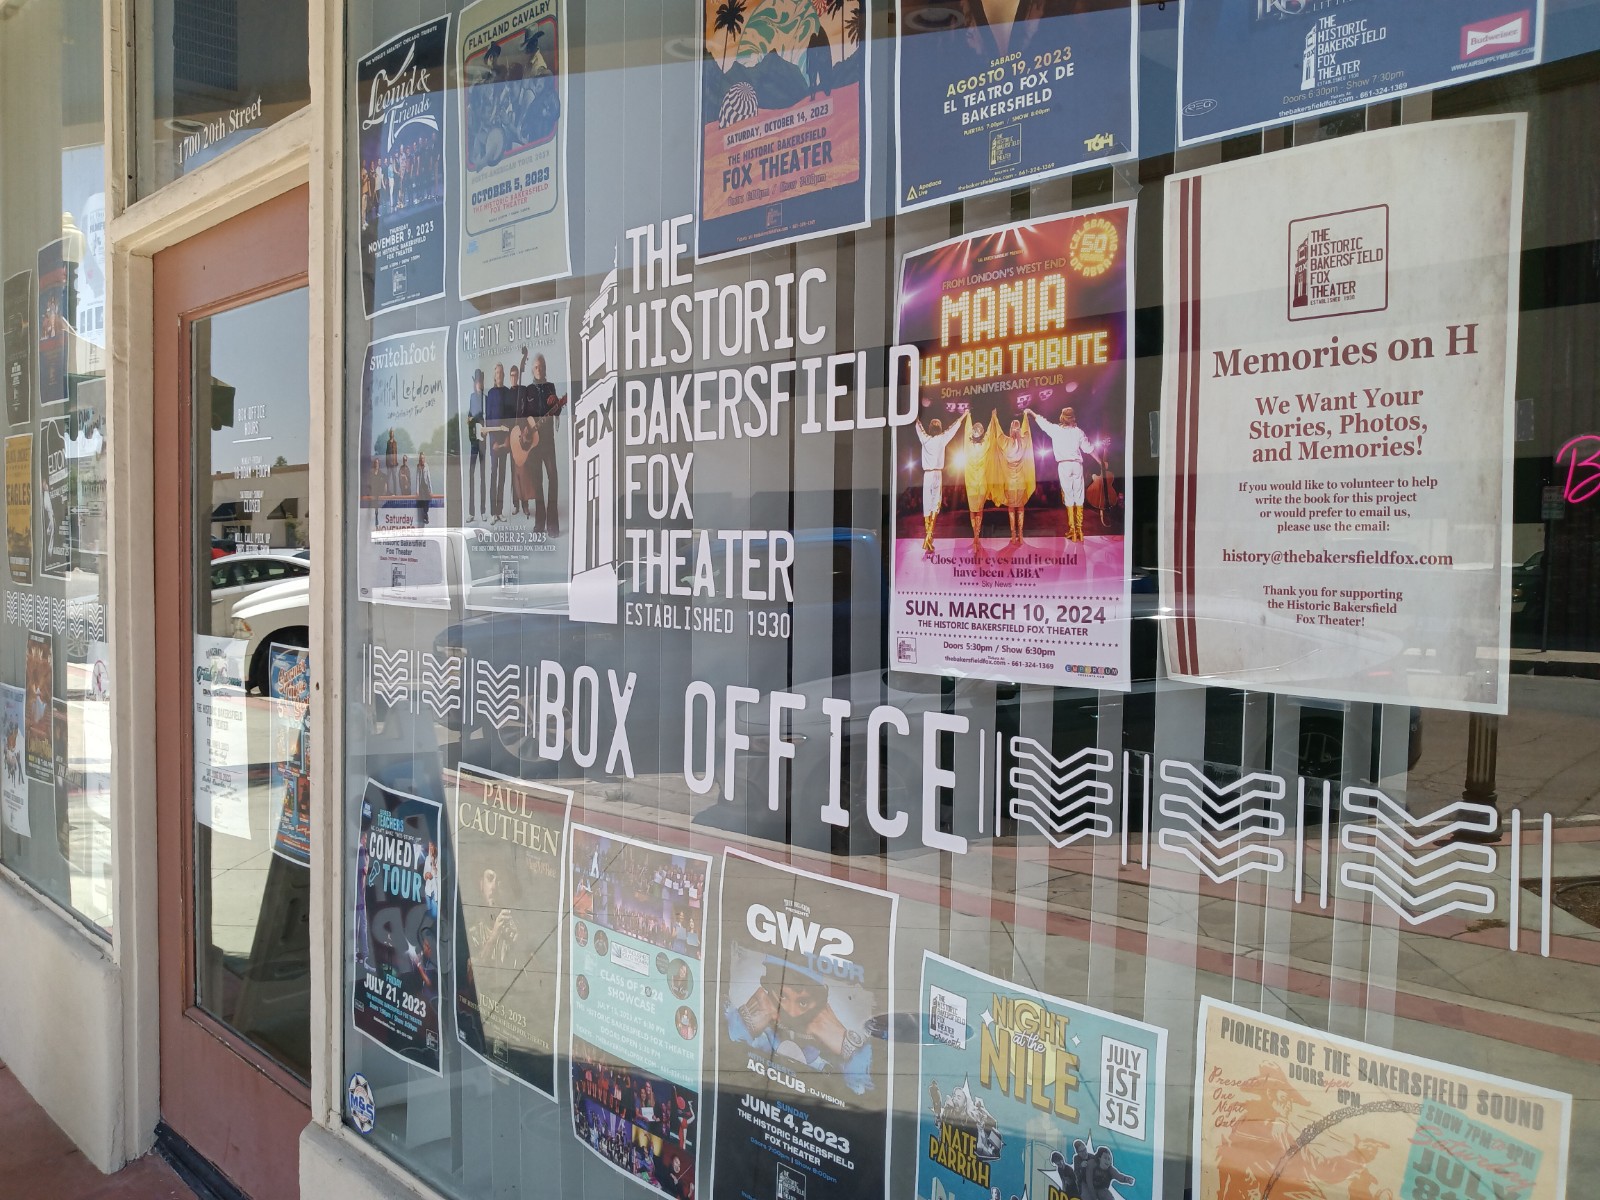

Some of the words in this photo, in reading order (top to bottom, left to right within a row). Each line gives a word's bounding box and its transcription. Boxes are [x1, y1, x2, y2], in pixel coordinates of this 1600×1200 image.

[469, 21, 510, 50] FLATLAND
[512, 0, 551, 28] CAVALRY
[1317, 19, 1368, 43] HISTORIC
[1318, 14, 1337, 30] THE
[1470, 29, 1519, 46] Budweiser
[990, 51, 1022, 68] SABADO
[1317, 27, 1387, 56] BAKERSFIELD
[946, 67, 1005, 98] AGOSTO
[1012, 60, 1031, 76] 19,
[1034, 46, 1072, 70] 2023
[1317, 52, 1336, 69] FOX
[1317, 59, 1361, 81] THEATER
[418, 68, 431, 93] &
[943, 99, 958, 114] EL
[963, 81, 1014, 108] TEATRO
[1020, 70, 1049, 91] FOX
[1055, 62, 1075, 81] DE
[726, 126, 762, 146] SATURDAY,
[764, 116, 795, 133] OCTOBER
[796, 111, 808, 123] 14,
[810, 104, 829, 119] 2023
[961, 88, 1053, 126] BAKERSFIELD
[178, 132, 201, 165] 1700
[203, 117, 226, 150] 20th
[228, 94, 262, 134] Street
[722, 162, 753, 193] FOX
[759, 140, 833, 181] THEATER
[471, 180, 512, 206] OCTOBER
[514, 177, 523, 191] 5,
[525, 167, 550, 186] 2023
[368, 231, 405, 254] NOVEMBER
[416, 220, 434, 237] 2023
[625, 214, 694, 294] THE
[942, 278, 966, 291] FROM
[966, 267, 1015, 285] LONDON'S
[1016, 263, 1042, 276] WEST
[1044, 257, 1067, 270] END
[625, 267, 827, 370] HISTORIC
[940, 273, 1066, 348] MANIA
[463, 323, 500, 352] MARTY
[508, 311, 559, 343] STUART
[369, 341, 437, 371] switchfoot
[947, 346, 1003, 383] ABBA
[1008, 331, 1108, 374] TRIBUTE
[1212, 335, 1378, 379] Memories
[1388, 334, 1435, 362] on
[1445, 323, 1479, 357] H
[625, 344, 920, 446] BAKERSFIELD
[1255, 396, 1291, 416] We
[1295, 391, 1358, 414] Want
[1363, 387, 1424, 409] Your
[574, 398, 613, 461] FOX
[1249, 416, 1332, 440] Stories,
[1339, 412, 1428, 436] Photos,
[1252, 440, 1292, 463] and
[1298, 434, 1423, 462] Memories!
[6, 482, 31, 506] EAGLES
[625, 452, 694, 520] FOX
[1238, 481, 1249, 493] If
[1249, 483, 1268, 493] you
[1269, 480, 1302, 492] would
[1304, 479, 1325, 490] like
[1326, 480, 1338, 490] to
[1340, 477, 1396, 490] volunteer
[1397, 478, 1409, 489] to
[1411, 476, 1438, 490] help
[1255, 494, 1283, 505] write
[1284, 493, 1303, 505] the
[1303, 493, 1331, 504] book
[1332, 493, 1350, 504] for
[1352, 492, 1374, 503] this
[1375, 492, 1417, 505] project
[385, 514, 414, 526] Saturday
[1259, 509, 1272, 518] or
[1274, 507, 1306, 518] would
[1308, 507, 1344, 521] prefer
[1345, 507, 1357, 517] to
[1358, 506, 1391, 517] email
[1393, 508, 1411, 519] us,
[1277, 521, 1311, 534] please
[1313, 523, 1332, 532] use
[1334, 522, 1352, 532] the
[1354, 521, 1390, 532] email:
[625, 529, 795, 602] THEATER
[953, 566, 978, 578] have
[979, 567, 1004, 578] been
[1222, 549, 1454, 566] history@thebakersfieldfox.com
[1262, 585, 1297, 597] Thank
[1298, 588, 1319, 599] you
[1321, 587, 1338, 598] for
[1339, 588, 1403, 601] supporting
[1267, 599, 1285, 610] the
[1286, 600, 1331, 611] Historic
[1332, 601, 1397, 614] Bakersfield
[625, 602, 734, 634] ESTABLISHED
[747, 611, 790, 639] 1930
[905, 600, 944, 618] SUN.
[949, 601, 1016, 621] MARCH
[1023, 603, 1050, 625] 10,
[1056, 605, 1107, 625] 2024
[918, 619, 933, 629] THE
[933, 620, 970, 630] HISTORIC
[971, 622, 1025, 633] BAKERSFIELD
[1026, 624, 1045, 634] FOX
[1046, 626, 1089, 637] THEATER
[1296, 613, 1315, 625] Fox
[1317, 614, 1365, 627] Theater!
[539, 659, 638, 779] BOX
[683, 679, 970, 855] OFFICE
[481, 780, 533, 819] PAUL
[459, 802, 561, 857] CAUTHEN
[369, 832, 423, 870] COMEDY
[383, 863, 422, 903] TOUR
[746, 903, 854, 968] GW2
[363, 972, 385, 996] JULY
[385, 983, 400, 1008] 21,
[402, 991, 427, 1018] 2023
[992, 991, 1072, 1052] NIGHT
[1012, 1030, 1027, 1046] at
[1026, 1032, 1046, 1054] the
[1106, 1043, 1141, 1071] JULY
[746, 1058, 765, 1077] AG
[766, 1067, 806, 1094] CLUB
[809, 1087, 820, 1097] DJ
[820, 1092, 846, 1108] VISION
[980, 1022, 1080, 1124] NILE
[1106, 1064, 1141, 1103] 1ST
[1220, 1016, 1290, 1059] PIONEERS
[1296, 1039, 1316, 1066] OF
[1323, 1046, 1352, 1077] THE
[1358, 1056, 1469, 1112] BAKERSFIELD
[1476, 1088, 1545, 1131] SOUND
[741, 1093, 781, 1123] JUNE
[783, 1113, 799, 1133] 4,
[801, 1120, 851, 1154] 2023
[776, 1100, 809, 1121] SUNDAY
[1105, 1096, 1140, 1130] $15
[737, 1108, 752, 1122] THE
[753, 1115, 791, 1141] HISTORIC
[792, 1134, 855, 1170] BAKERSFIELD
[764, 1132, 781, 1147] FOX
[782, 1141, 821, 1167] THEATER
[940, 1122, 977, 1159] NATE
